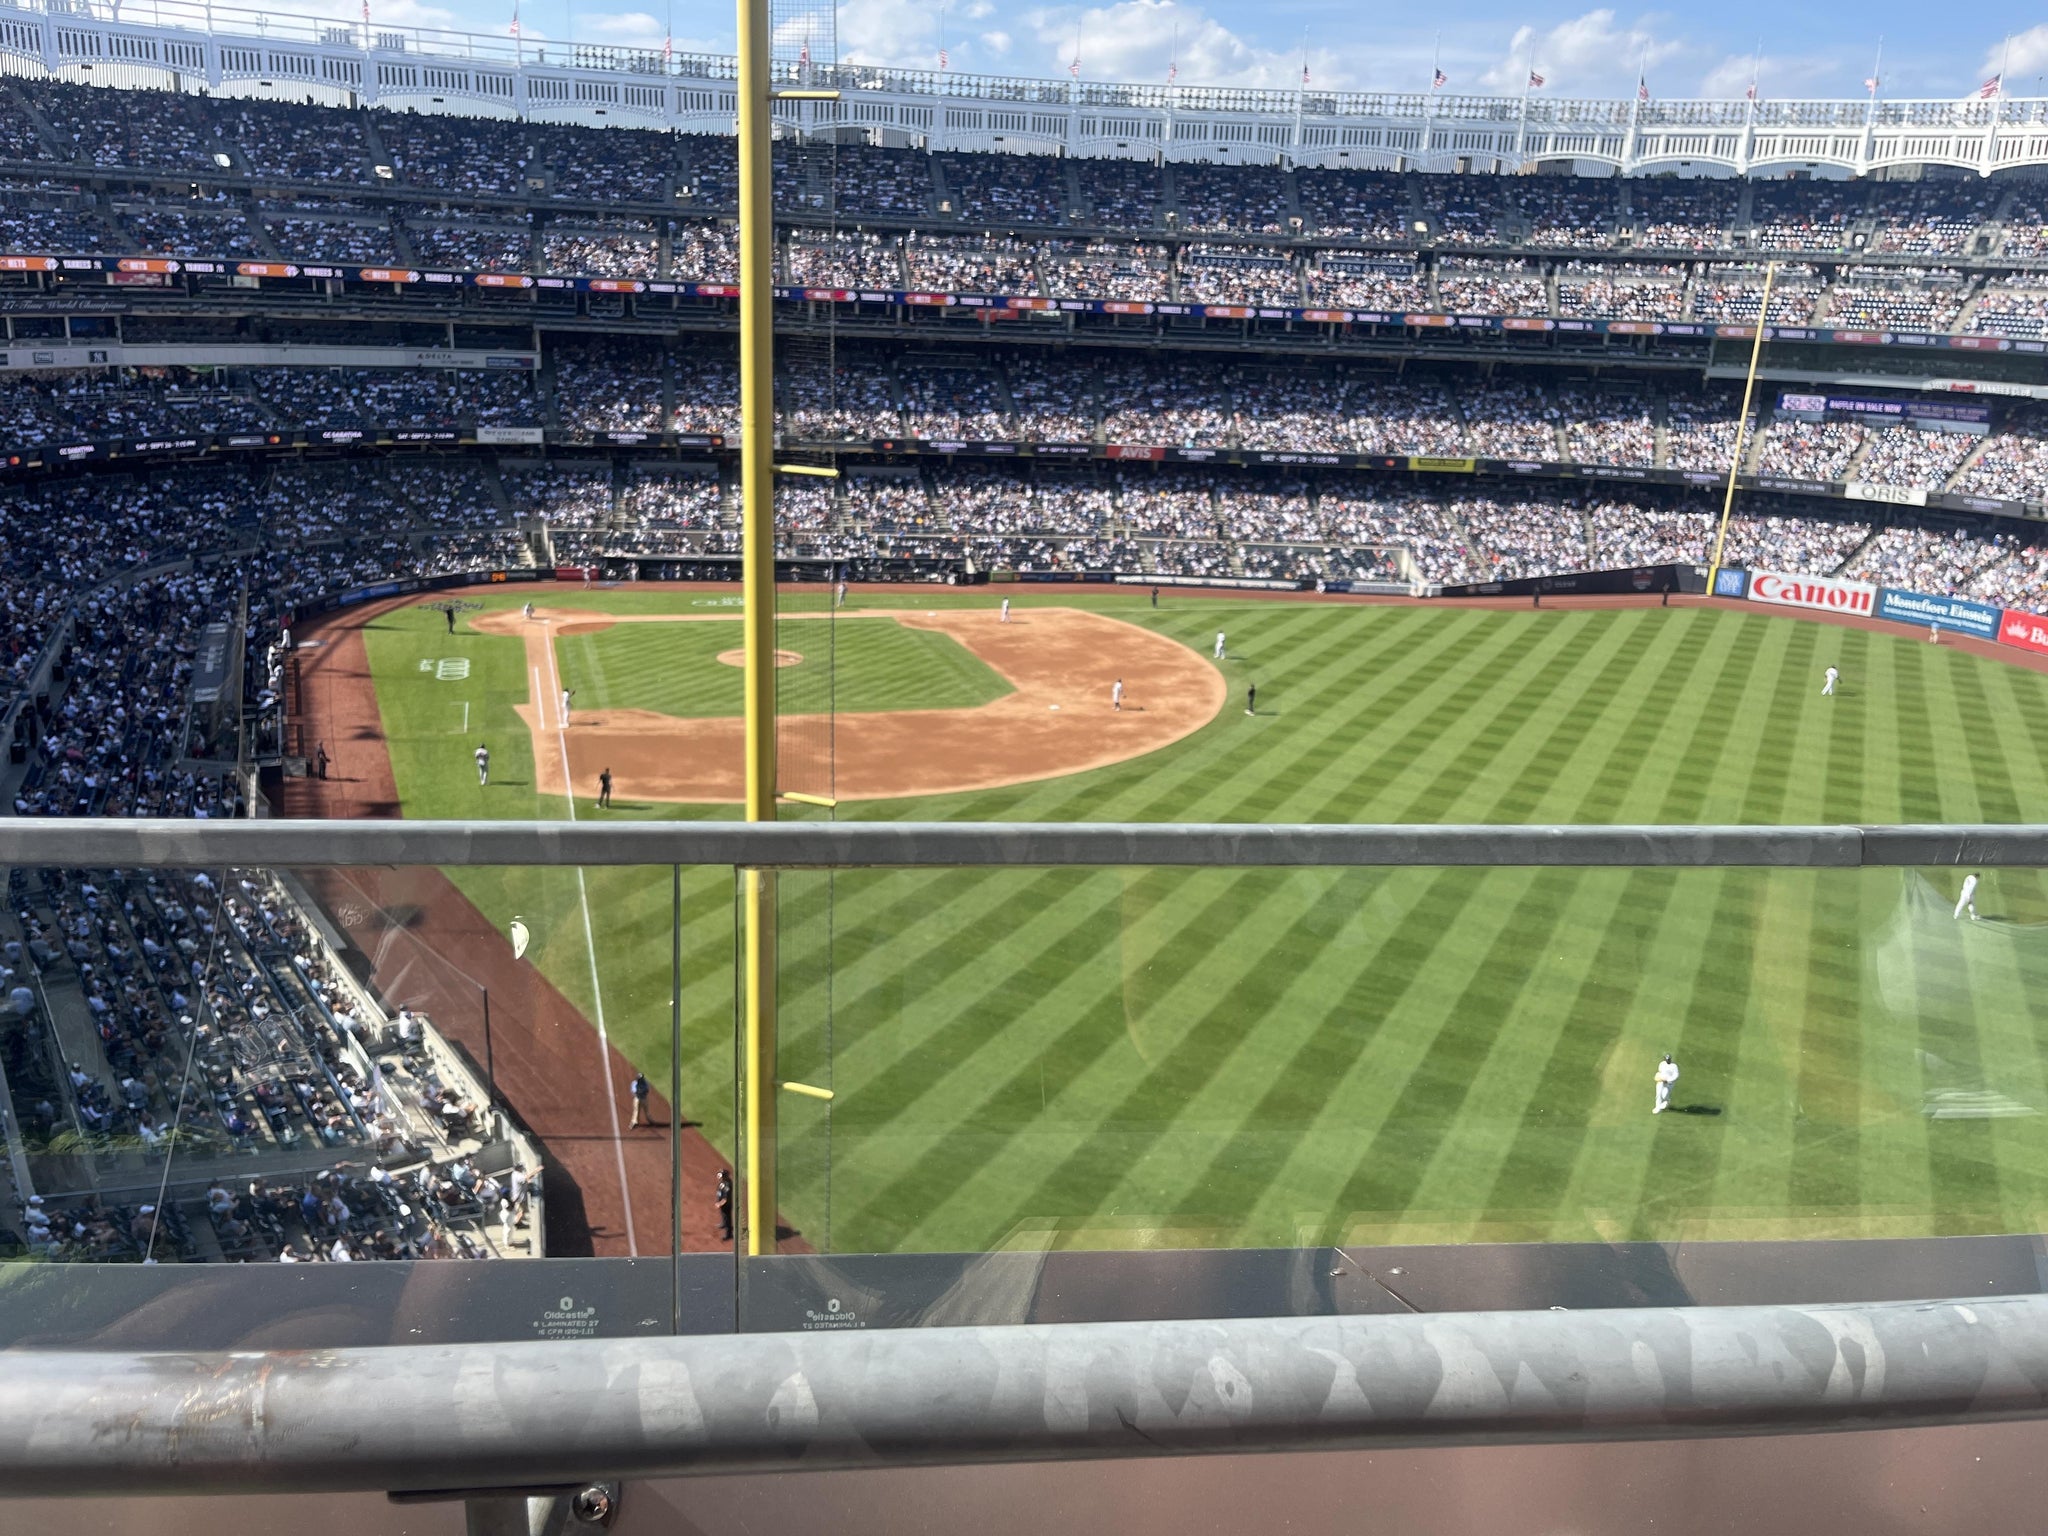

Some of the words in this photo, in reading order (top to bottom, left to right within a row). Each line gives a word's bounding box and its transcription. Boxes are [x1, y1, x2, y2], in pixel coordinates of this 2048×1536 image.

[1119, 447, 1152, 459] AVIS
[1861, 485, 1909, 503] ORIS
[1753, 574, 1871, 612] Canon
[1885, 593, 1949, 616] Montefiore
[1950, 604, 1994, 625] Einstein
[544, 1311, 589, 1319] Oldcastle
